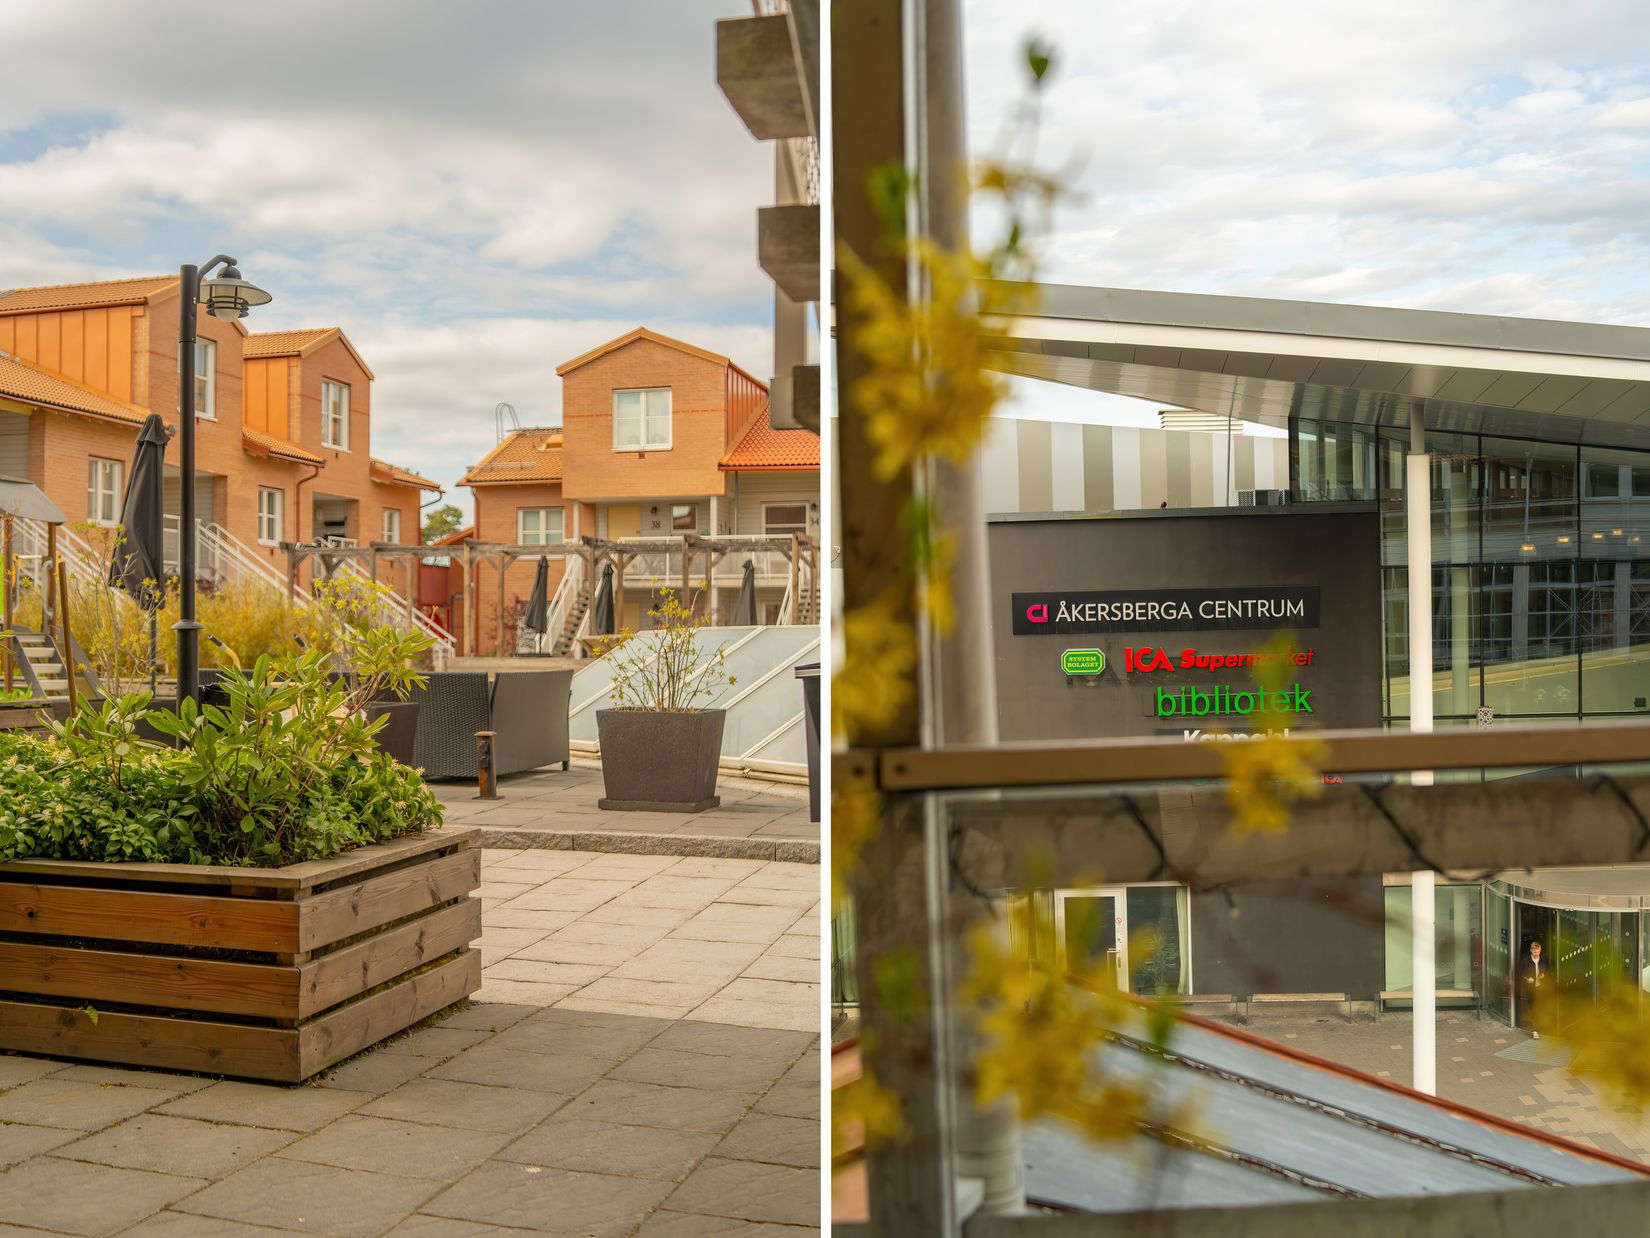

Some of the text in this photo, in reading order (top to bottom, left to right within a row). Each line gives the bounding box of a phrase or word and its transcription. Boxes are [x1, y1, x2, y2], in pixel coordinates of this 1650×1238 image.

[1055, 600, 1193, 622] ÅKERSBERGA
[1198, 598, 1305, 619] CENTRUM
[1124, 645, 1314, 673] ICA Supermket
[1156, 683, 1313, 717] bibliotek
